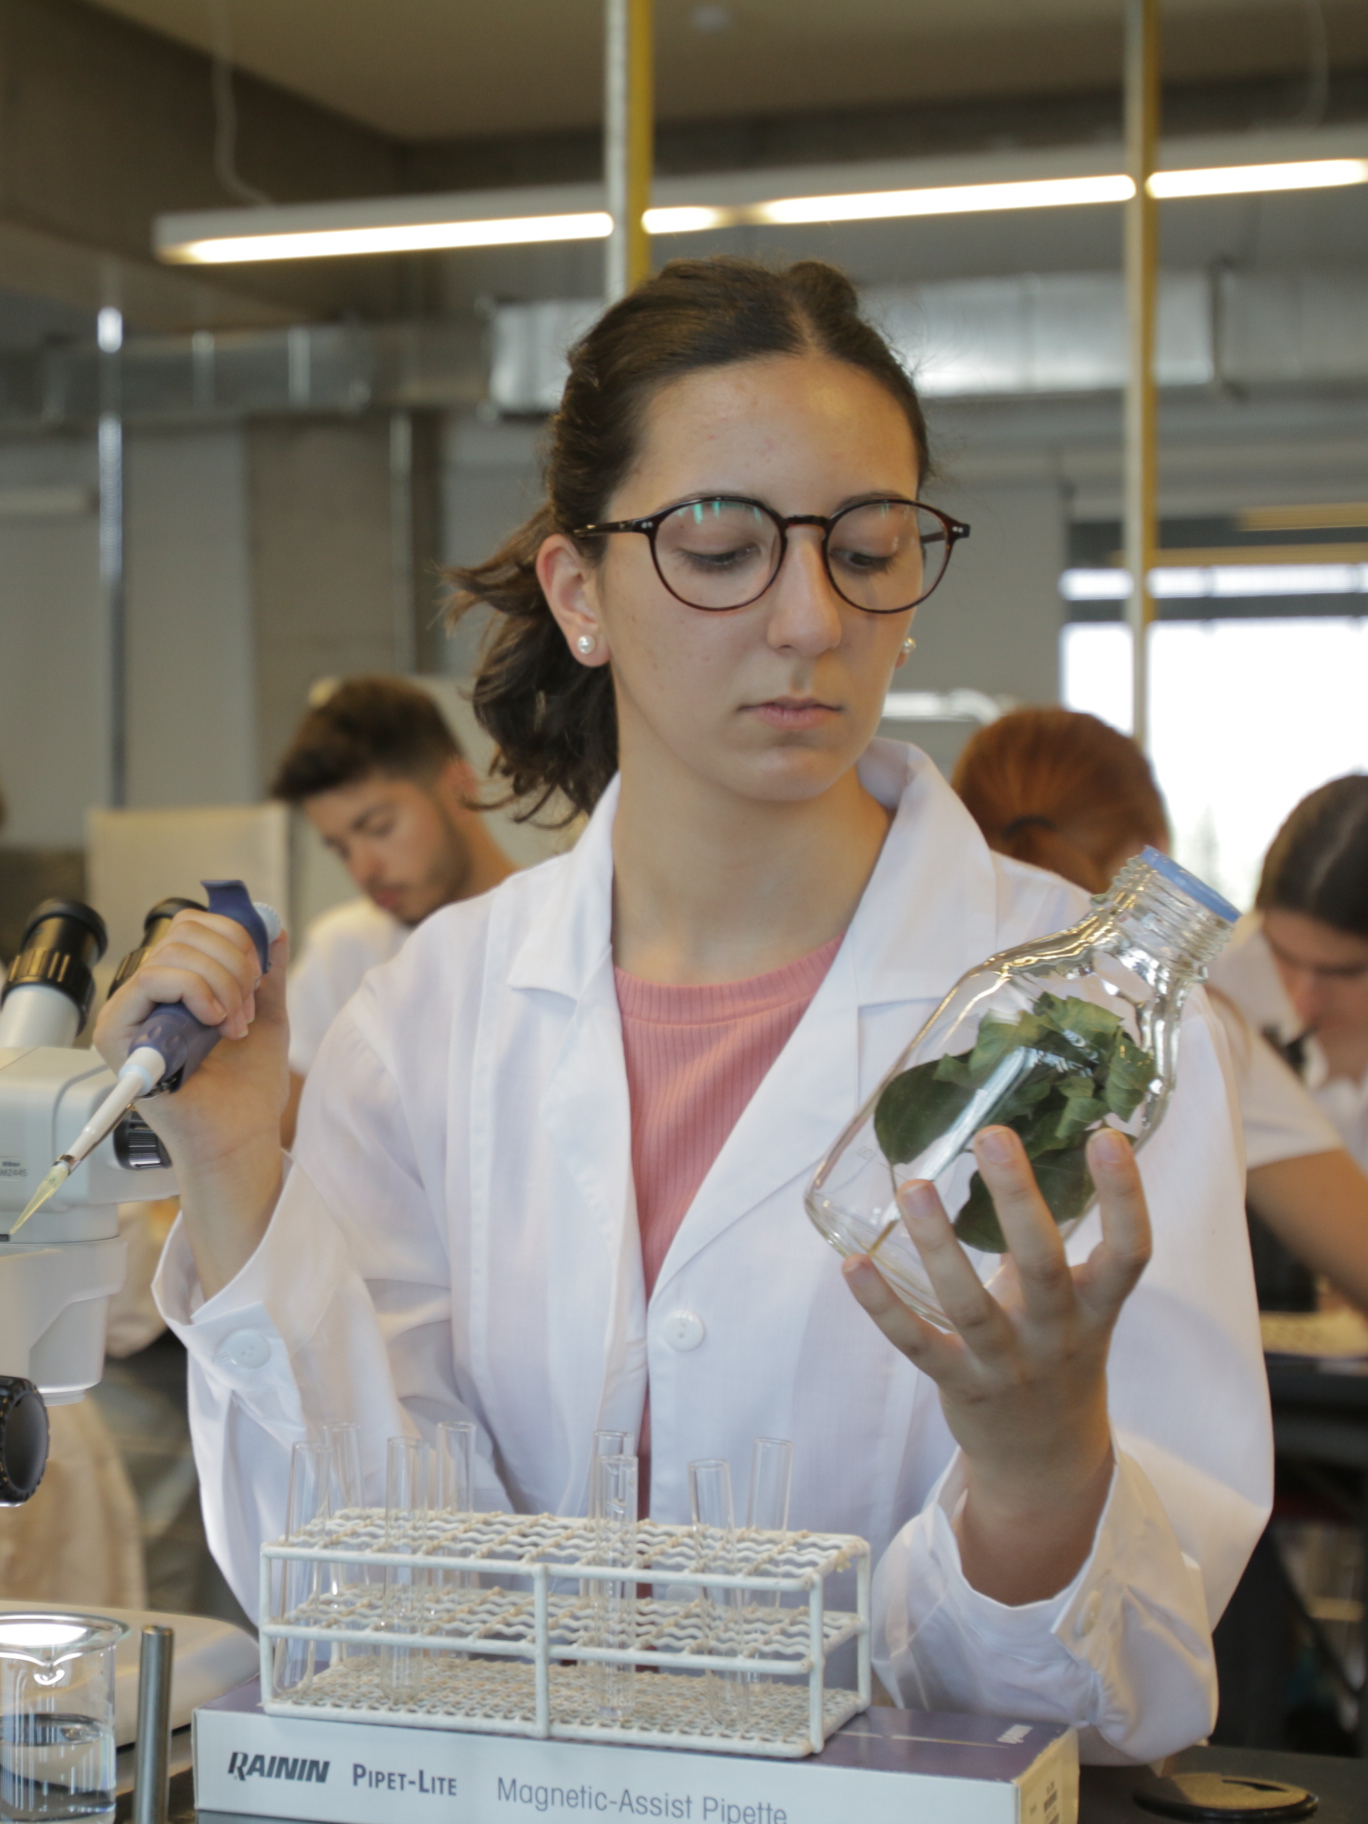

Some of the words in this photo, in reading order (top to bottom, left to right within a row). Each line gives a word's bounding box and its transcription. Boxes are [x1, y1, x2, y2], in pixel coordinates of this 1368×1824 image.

[227, 1750, 331, 1784] RAININ
[496, 1776, 693, 1820] Magnetic-Assist
[702, 1796, 788, 1824] Pipette
